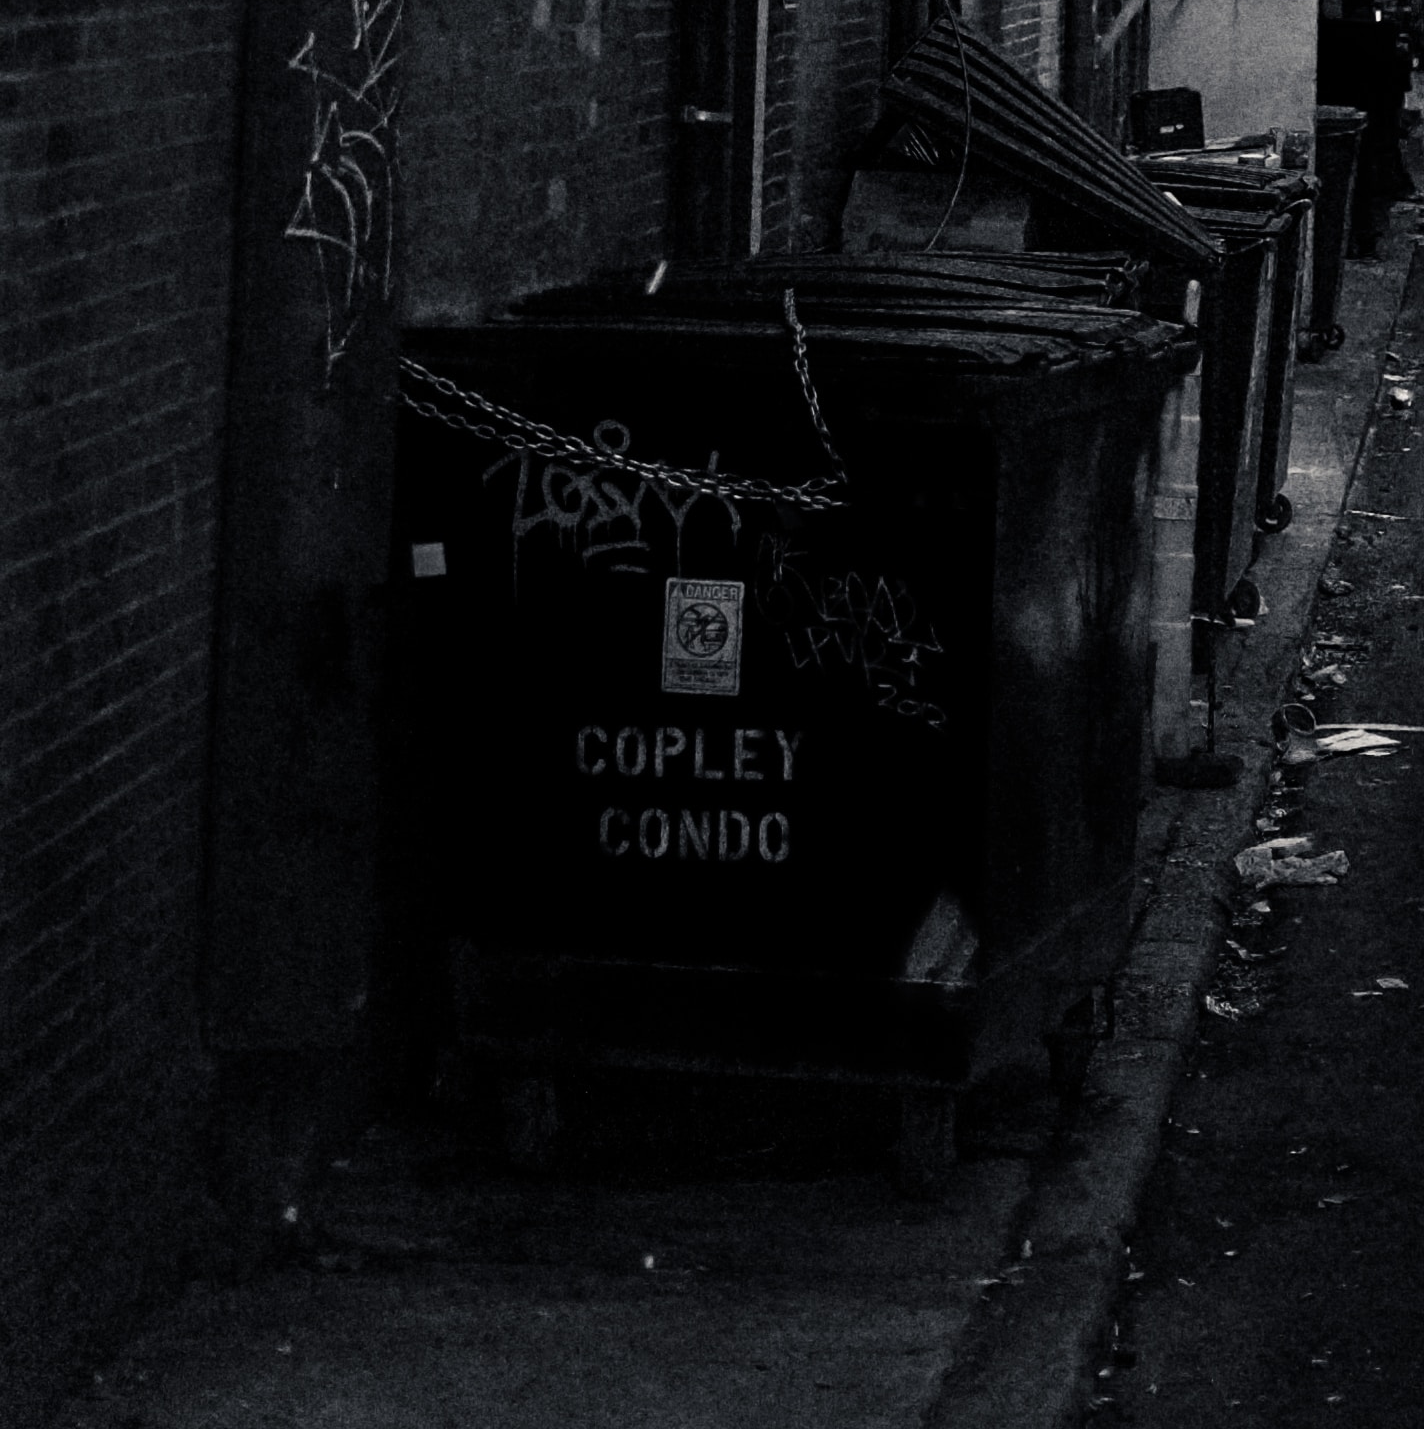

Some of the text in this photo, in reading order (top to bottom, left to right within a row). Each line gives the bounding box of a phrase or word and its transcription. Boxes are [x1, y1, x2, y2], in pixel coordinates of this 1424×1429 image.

[686, 584, 738, 600] DANGER
[574, 724, 807, 782] COPLEY
[599, 806, 792, 863] CONDO
